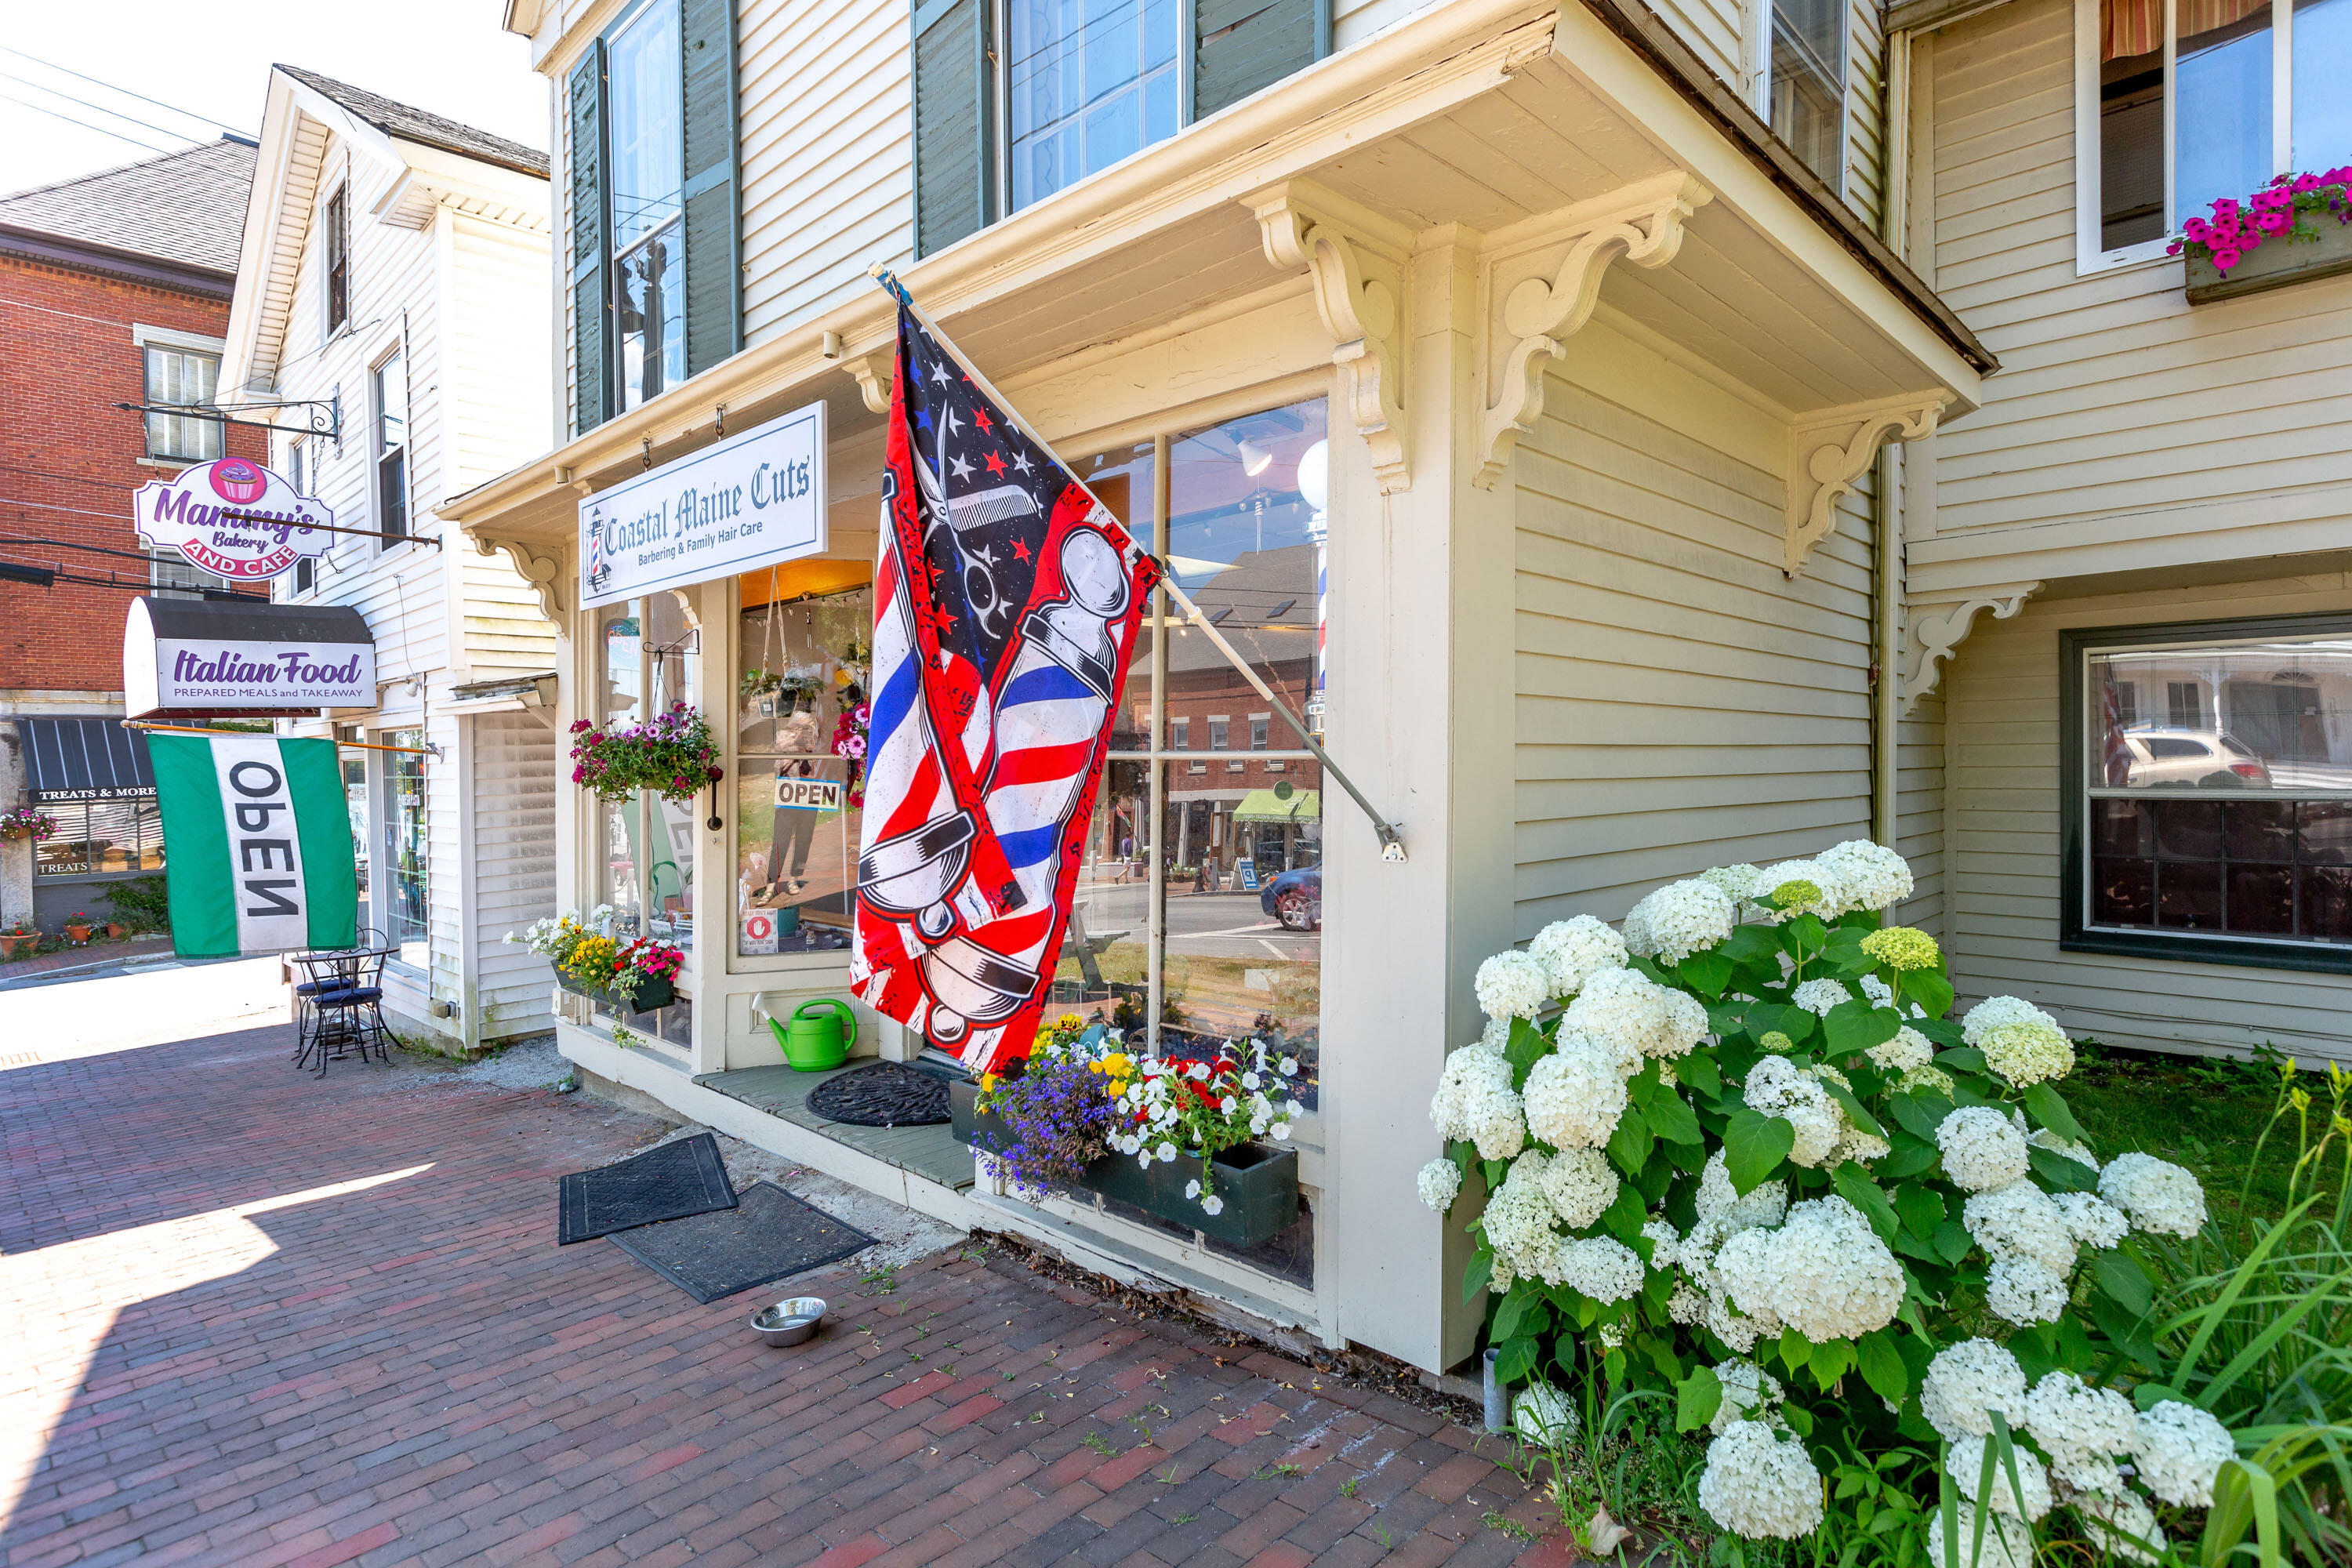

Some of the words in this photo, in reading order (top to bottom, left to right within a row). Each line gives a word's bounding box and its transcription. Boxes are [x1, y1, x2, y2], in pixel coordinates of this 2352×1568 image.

[154, 488, 320, 545] Mammy's
[604, 499, 668, 557] Coastal
[674, 481, 742, 540] Maine
[212, 531, 269, 554] Bakery
[638, 544, 676, 566] Barbering
[678, 541, 684, 554] &
[687, 532, 715, 554] Family
[718, 527, 738, 543] Hair
[740, 521, 763, 538] Care
[184, 543, 236, 572] AND
[244, 546, 297, 575] CAFE
[174, 649, 281, 683] Italian
[277, 652, 361, 684] Food
[174, 688, 236, 697] PREPARED
[239, 688, 277, 697] MEALS
[301, 688, 363, 697] TAKEAWAY
[39, 789, 96, 800] TREATS
[100, 788, 111, 797] &
[116, 786, 157, 797] MORE
[779, 782, 837, 806] OPEN
[38, 862, 88, 873] TREATS
